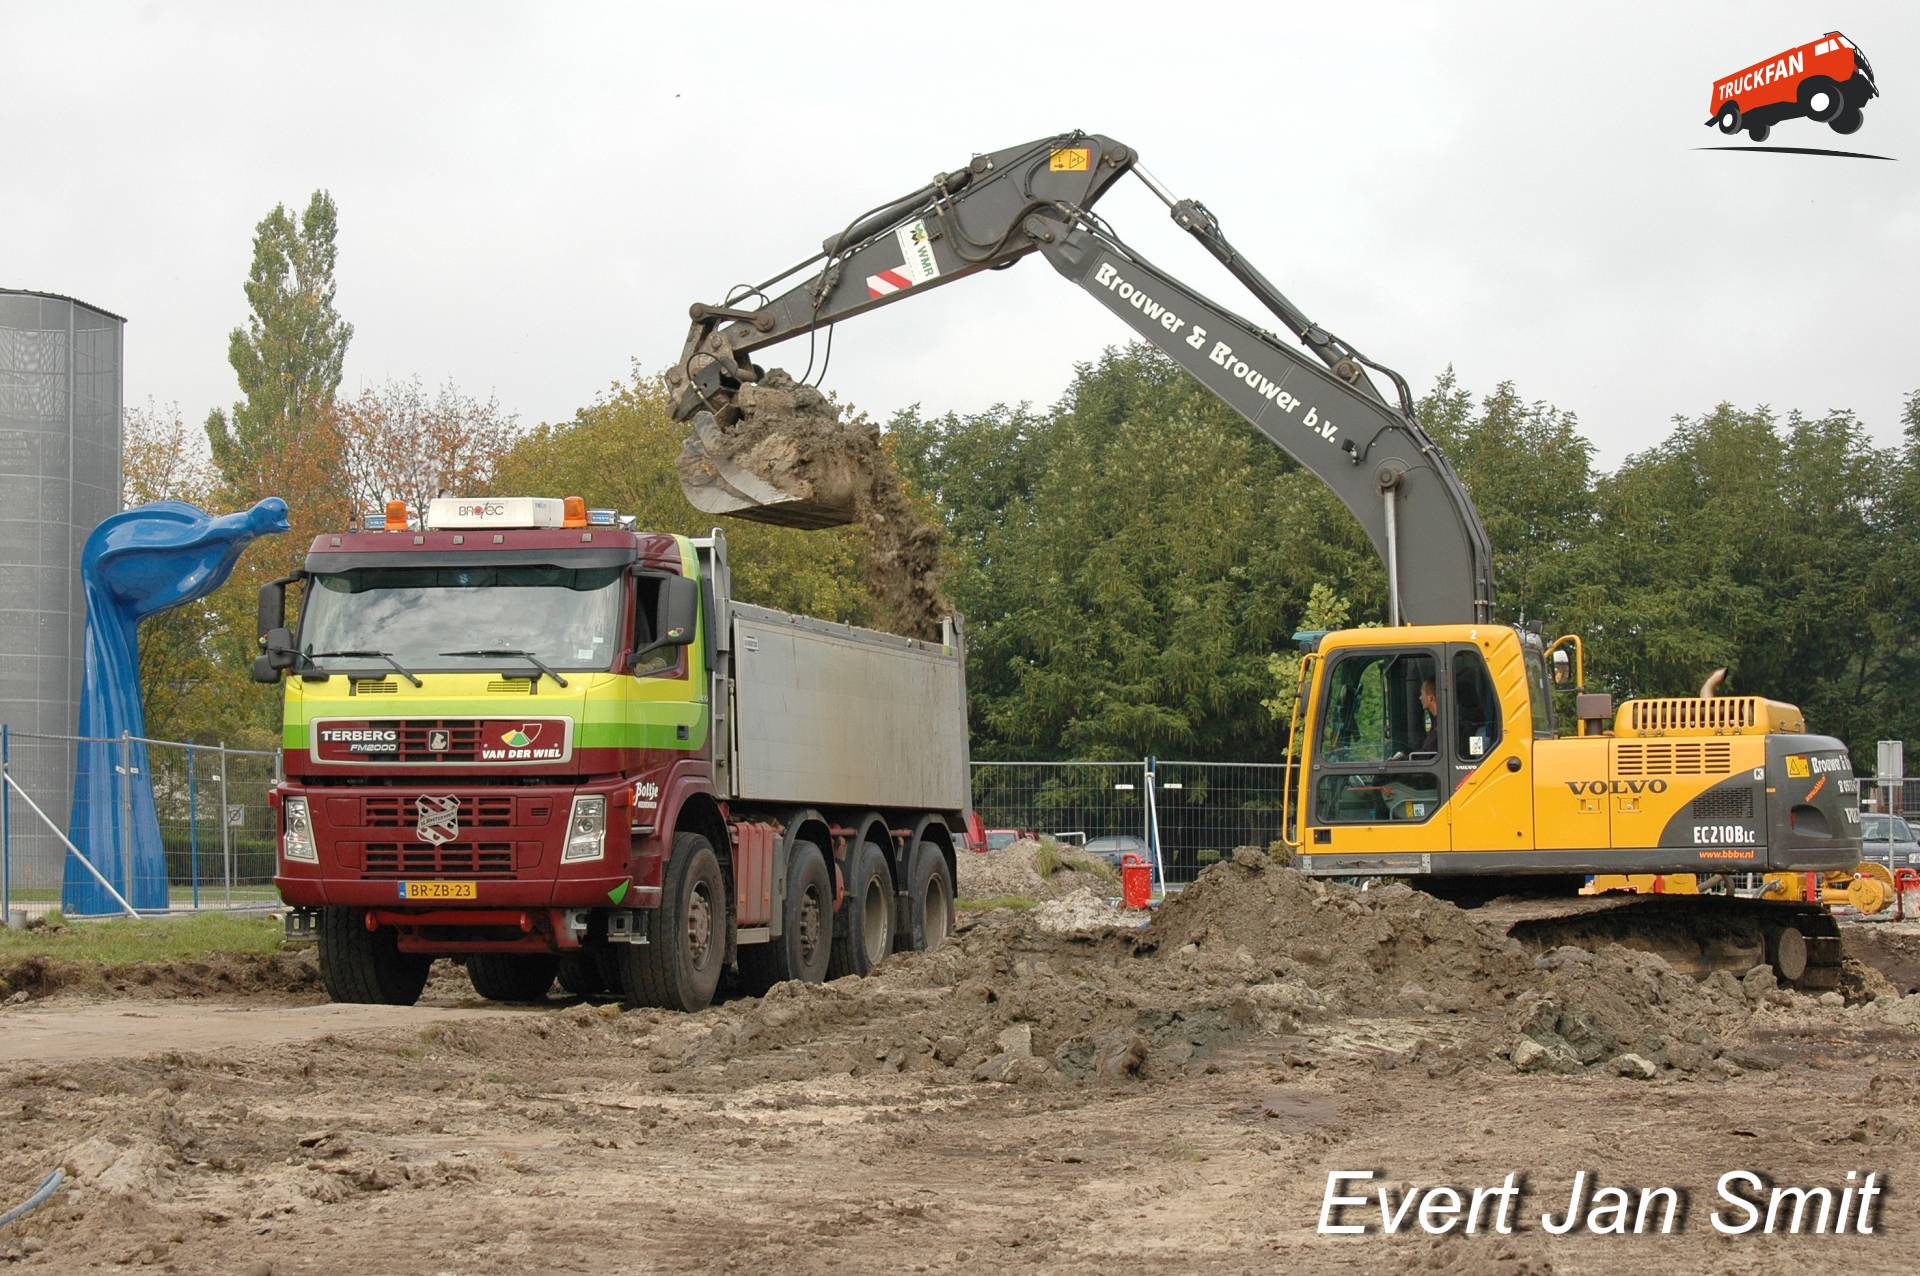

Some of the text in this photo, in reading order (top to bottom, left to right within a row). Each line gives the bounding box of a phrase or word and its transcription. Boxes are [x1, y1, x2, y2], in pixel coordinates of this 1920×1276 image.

[917, 245, 934, 277] WMR
[1094, 263, 1185, 334] Brouwer
[1186, 325, 1208, 350] &
[1208, 341, 1301, 414] Brouwer
[321, 730, 397, 741] TERBERG
[350, 743, 397, 752] FM2000
[482, 748, 562, 759] VAN DER WIEL
[633, 782, 659, 806] Boltje
[1565, 779, 1667, 796] VOLVO
[1699, 850, 1755, 859] www.bbbv.nl
[411, 884, 471, 897] BR-ZB-23
